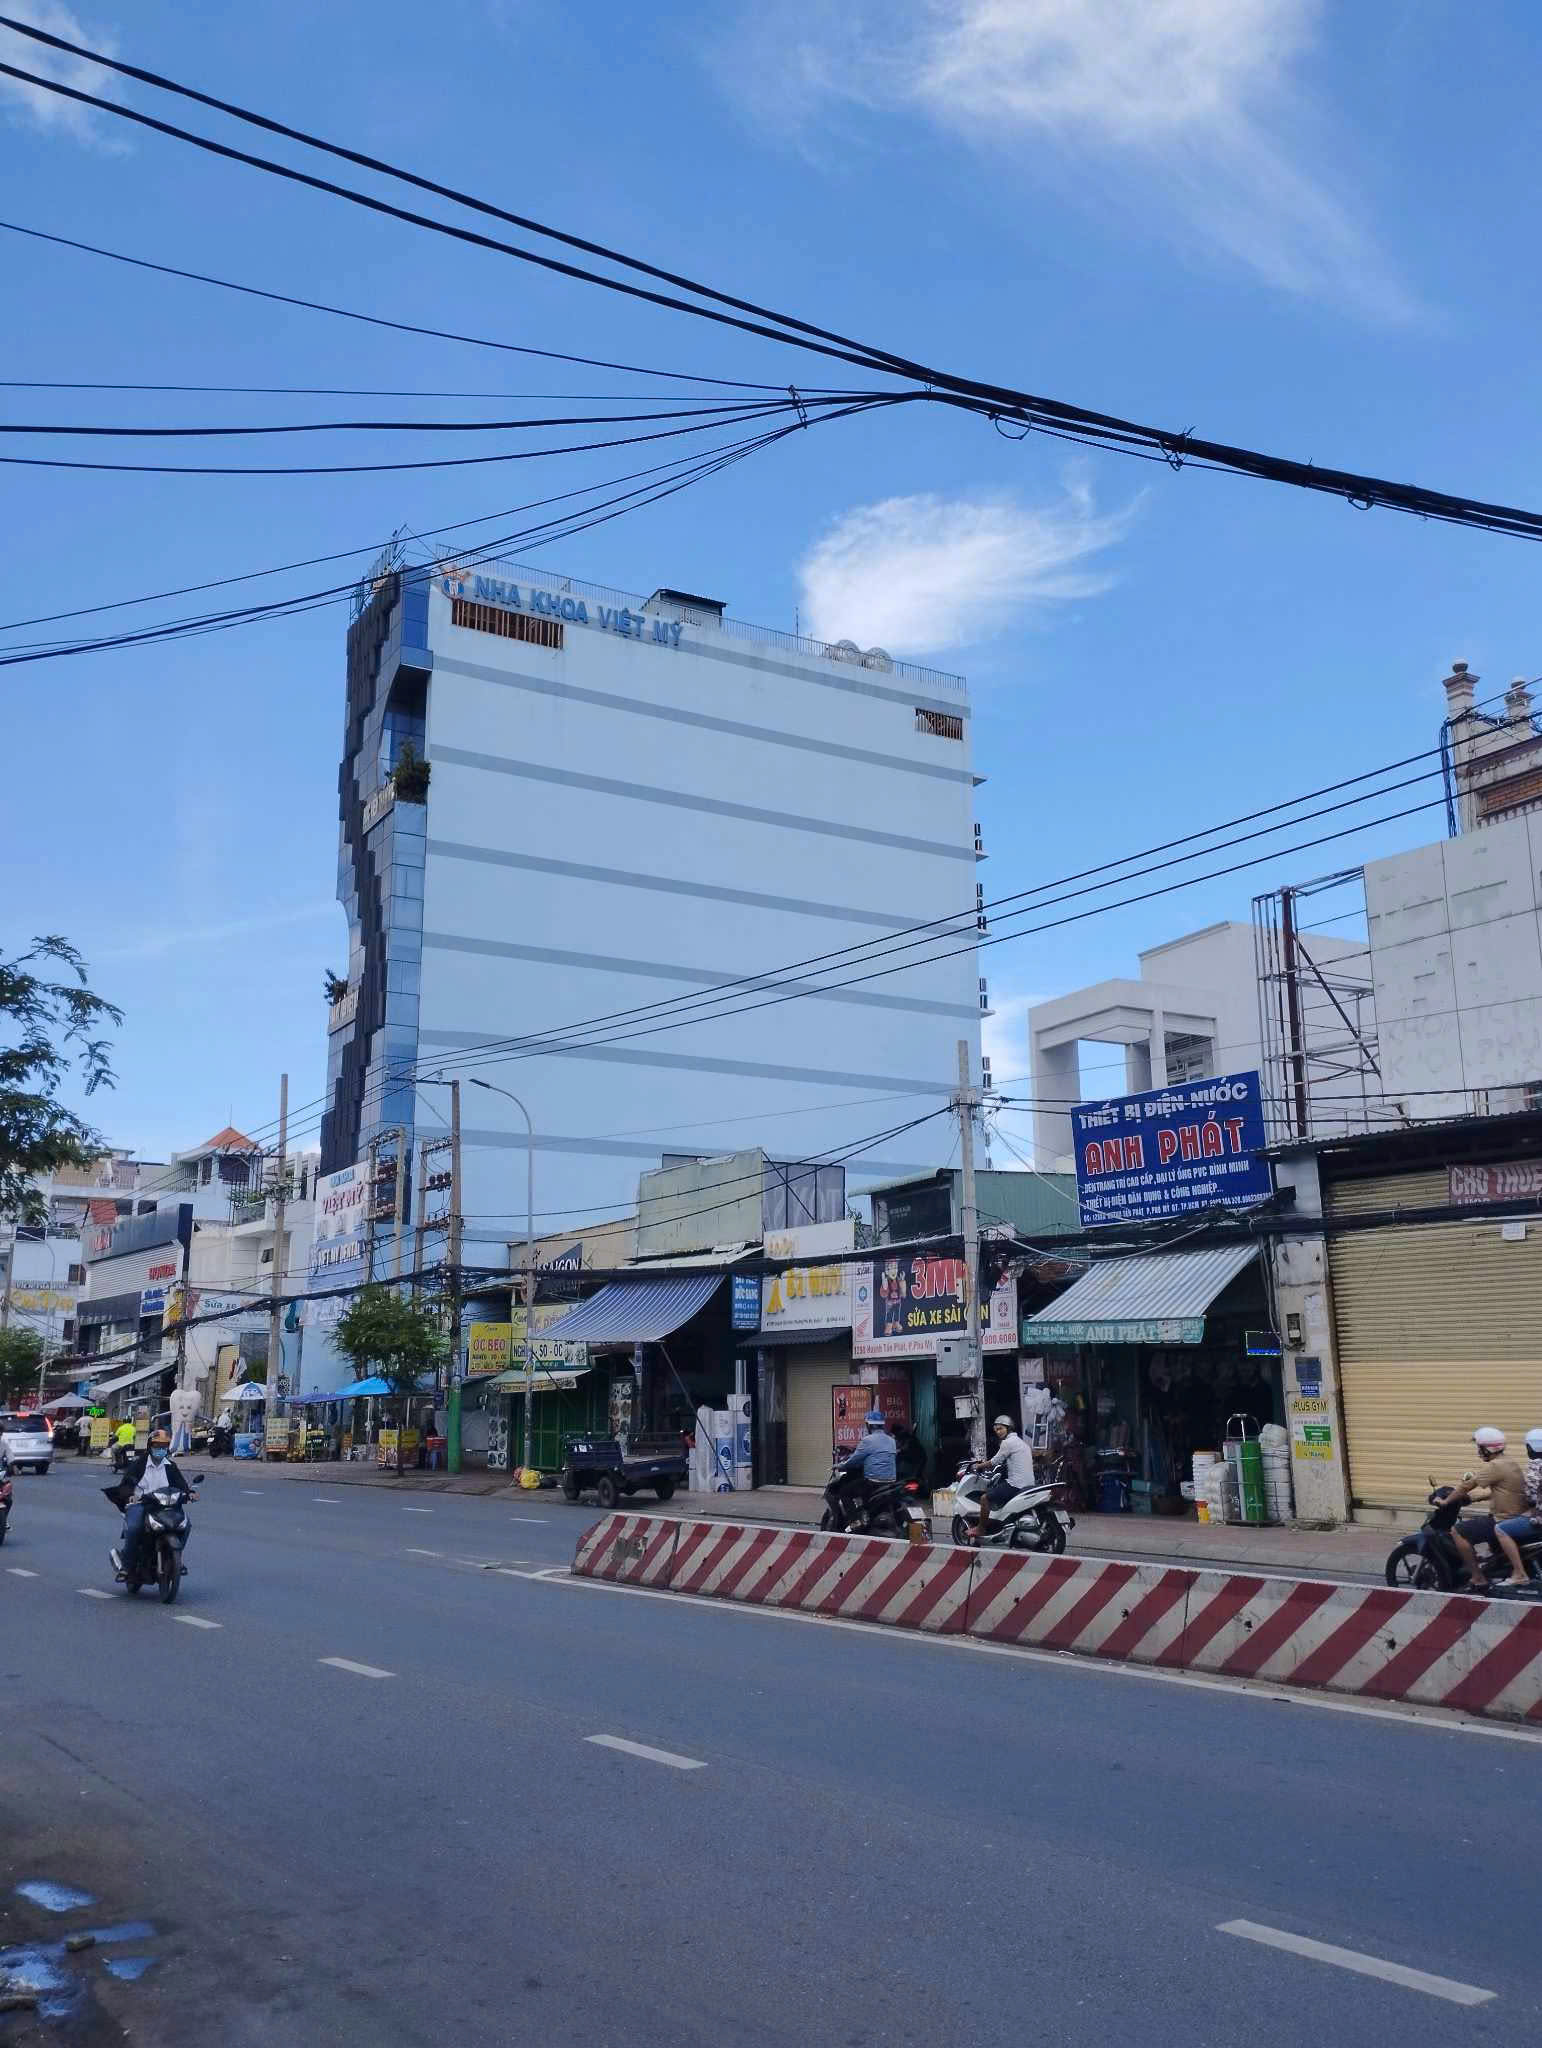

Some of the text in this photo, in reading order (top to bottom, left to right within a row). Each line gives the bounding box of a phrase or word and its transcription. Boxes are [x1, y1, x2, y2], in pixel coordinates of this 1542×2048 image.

[474, 575, 521, 608] NHA
[530, 588, 589, 624] KHOA
[598, 605, 645, 639] VIỆT
[1079, 1100, 1120, 1129] THIẾT
[1125, 1104, 1141, 1124] BỊ
[1085, 1111, 1245, 1176] ANH PHÁT
[1193, 1166, 1207, 1179] PVC
[1209, 1162, 1228, 1176] BÌNH
[1228, 1160, 1249, 1173] MINH
[1451, 1167, 1489, 1196] CHO
[1164, 1189, 1170, 1200] &
[1171, 1185, 1190, 1199] CÔNG
[907, 1306, 928, 1328] SỬA
[930, 1308, 942, 1325] XE
[944, 1303, 961, 1324] SÀI
[1088, 1325, 1115, 1340] ANH
